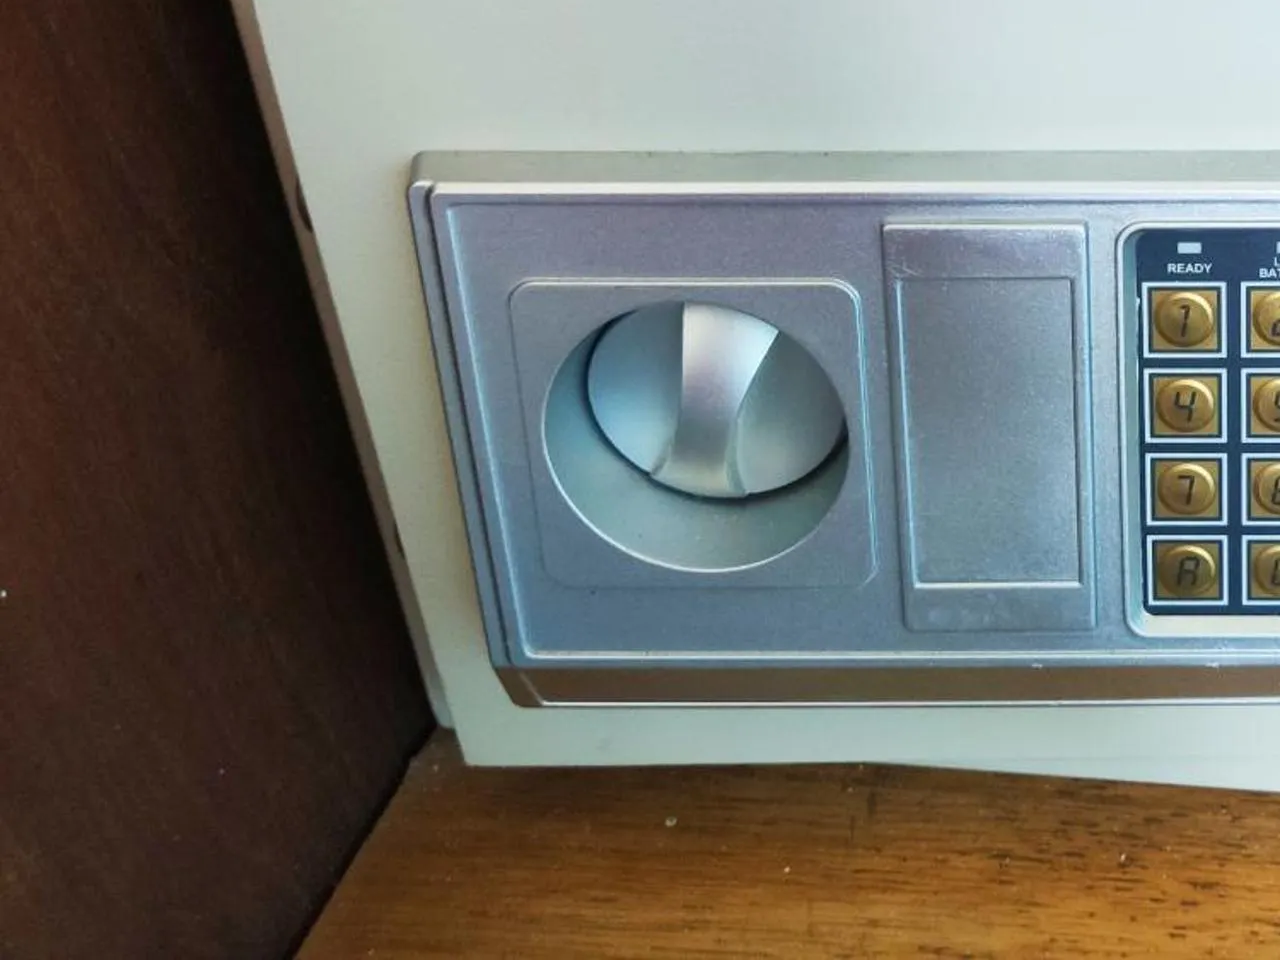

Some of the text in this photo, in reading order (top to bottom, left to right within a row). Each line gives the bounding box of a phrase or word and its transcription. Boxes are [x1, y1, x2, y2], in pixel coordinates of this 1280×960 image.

[1167, 262, 1213, 274] READY
[1174, 391, 1197, 423] 4
[1177, 475, 1196, 506] 7
[1177, 556, 1200, 586] A
